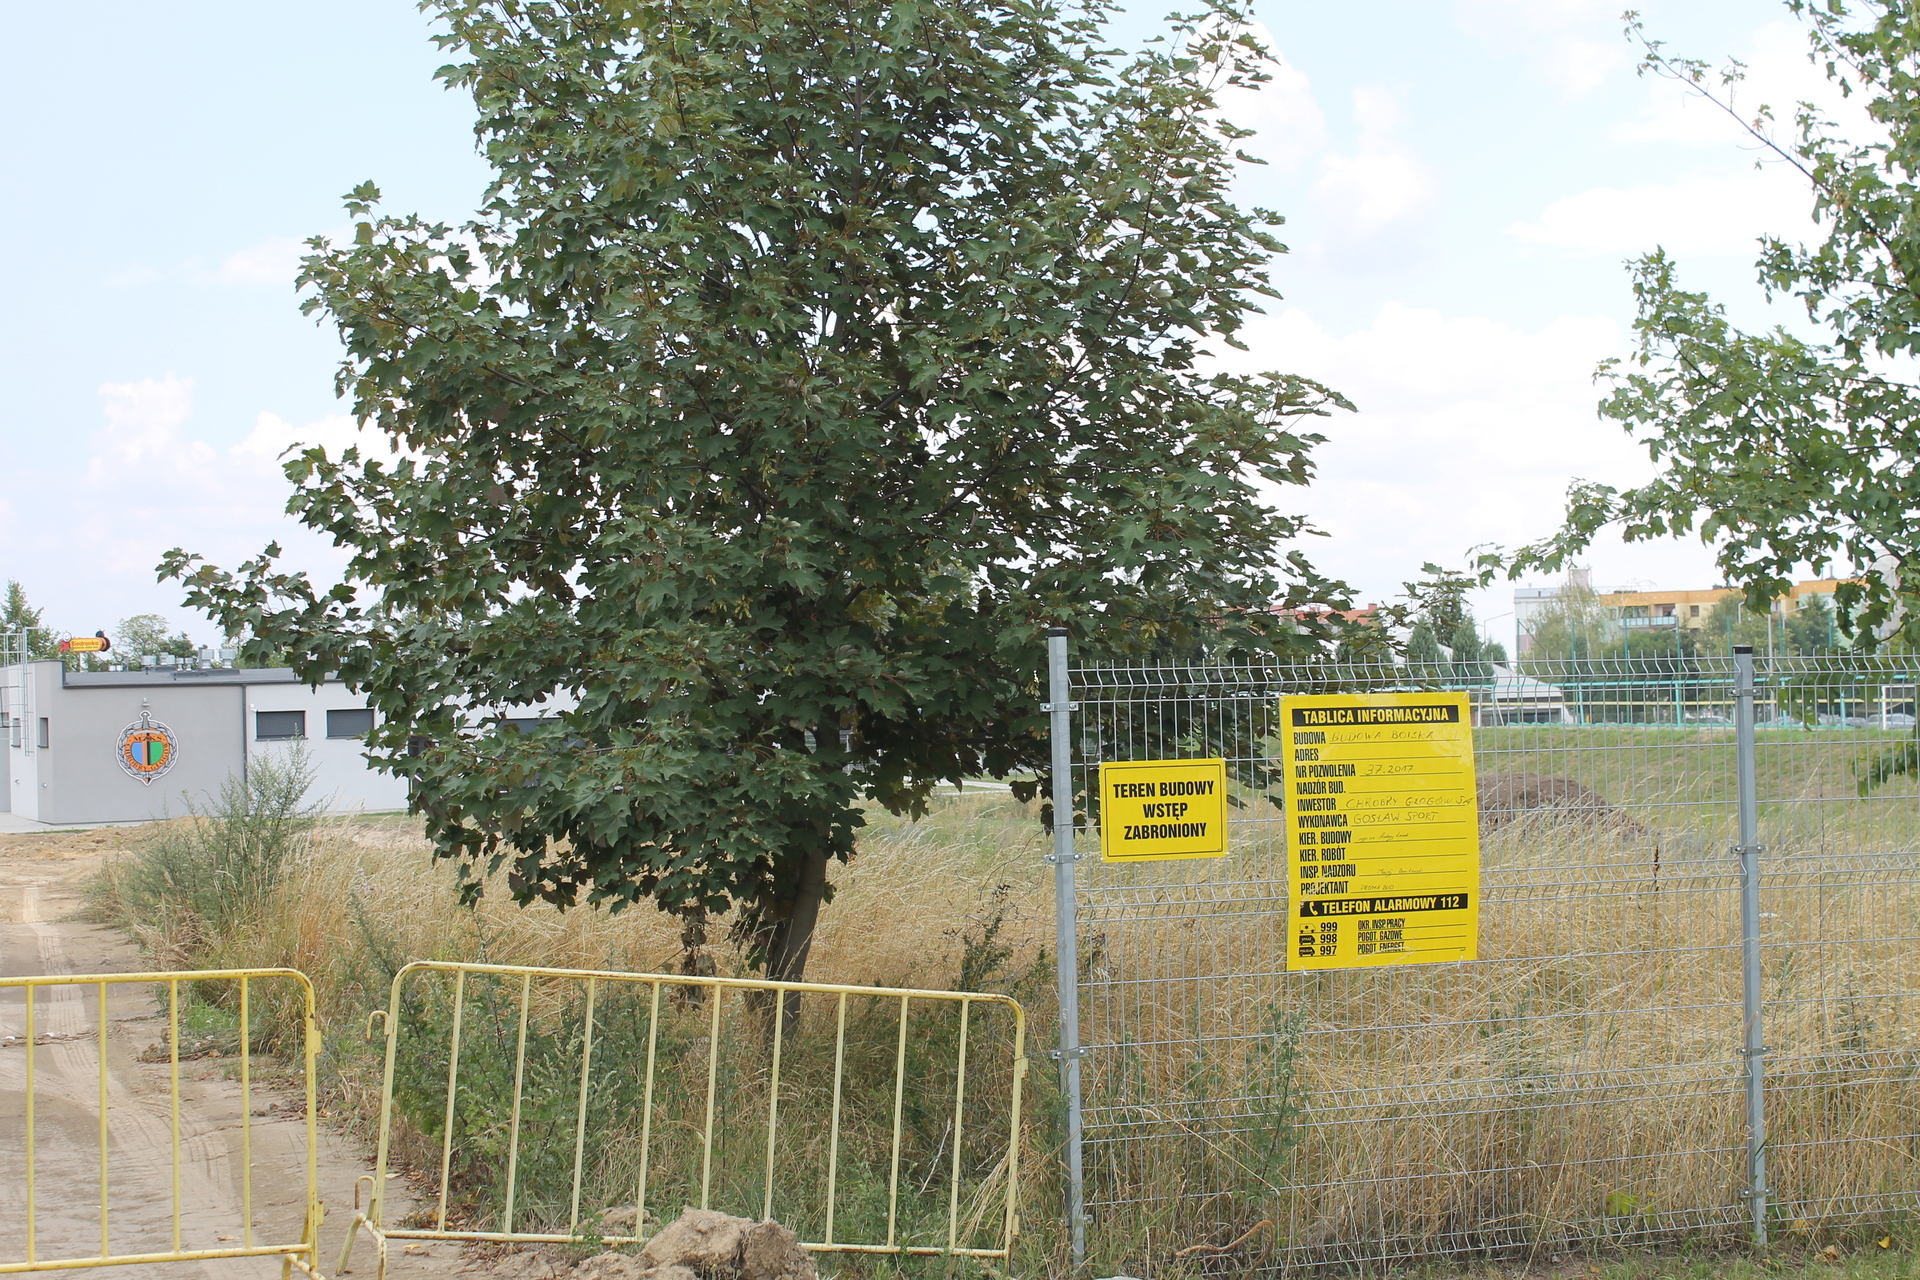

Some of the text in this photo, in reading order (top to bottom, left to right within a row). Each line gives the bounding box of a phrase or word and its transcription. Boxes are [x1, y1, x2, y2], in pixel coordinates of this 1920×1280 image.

[1303, 707, 1449, 725] TABLICA INFORMACYJNA
[1293, 731, 1326, 745] BUDOWA
[1331, 730, 1434, 742] BUDOWA BOISKA
[1294, 748, 1319, 762] ADRES
[1295, 764, 1356, 779] NR POZWOLENIA
[1364, 764, 1414, 776] 37.2017
[1113, 780, 1214, 798] TEREN BUDOWY
[1296, 779, 1346, 795] NADZÓR BUD.
[1297, 797, 1336, 812] INWESTOR
[1345, 796, 1398, 808] CHROBRY
[1143, 802, 1188, 821] WSTĘP
[1353, 811, 1440, 825] GOSŁAW SPORT
[1297, 814, 1348, 829] WYKONAWCA
[1124, 822, 1207, 840] ZABRONIONY
[1299, 830, 1352, 846] KIER. BUDOWY
[1299, 846, 1346, 862] KIER. ROBÓT
[1300, 864, 1356, 879] INSP. NADZORU
[1300, 881, 1349, 896] PROJEKTANT
[1322, 895, 1460, 914] TELEFON ALARMOWY 112
[1320, 922, 1338, 933] 999
[1357, 918, 1406, 930] OKR. INSP. PRACY
[1320, 934, 1338, 944] 998
[1357, 930, 1403, 942] POGOT. GAZOWE
[1319, 945, 1337, 956] 997
[1357, 943, 1378, 954] POGOT.
